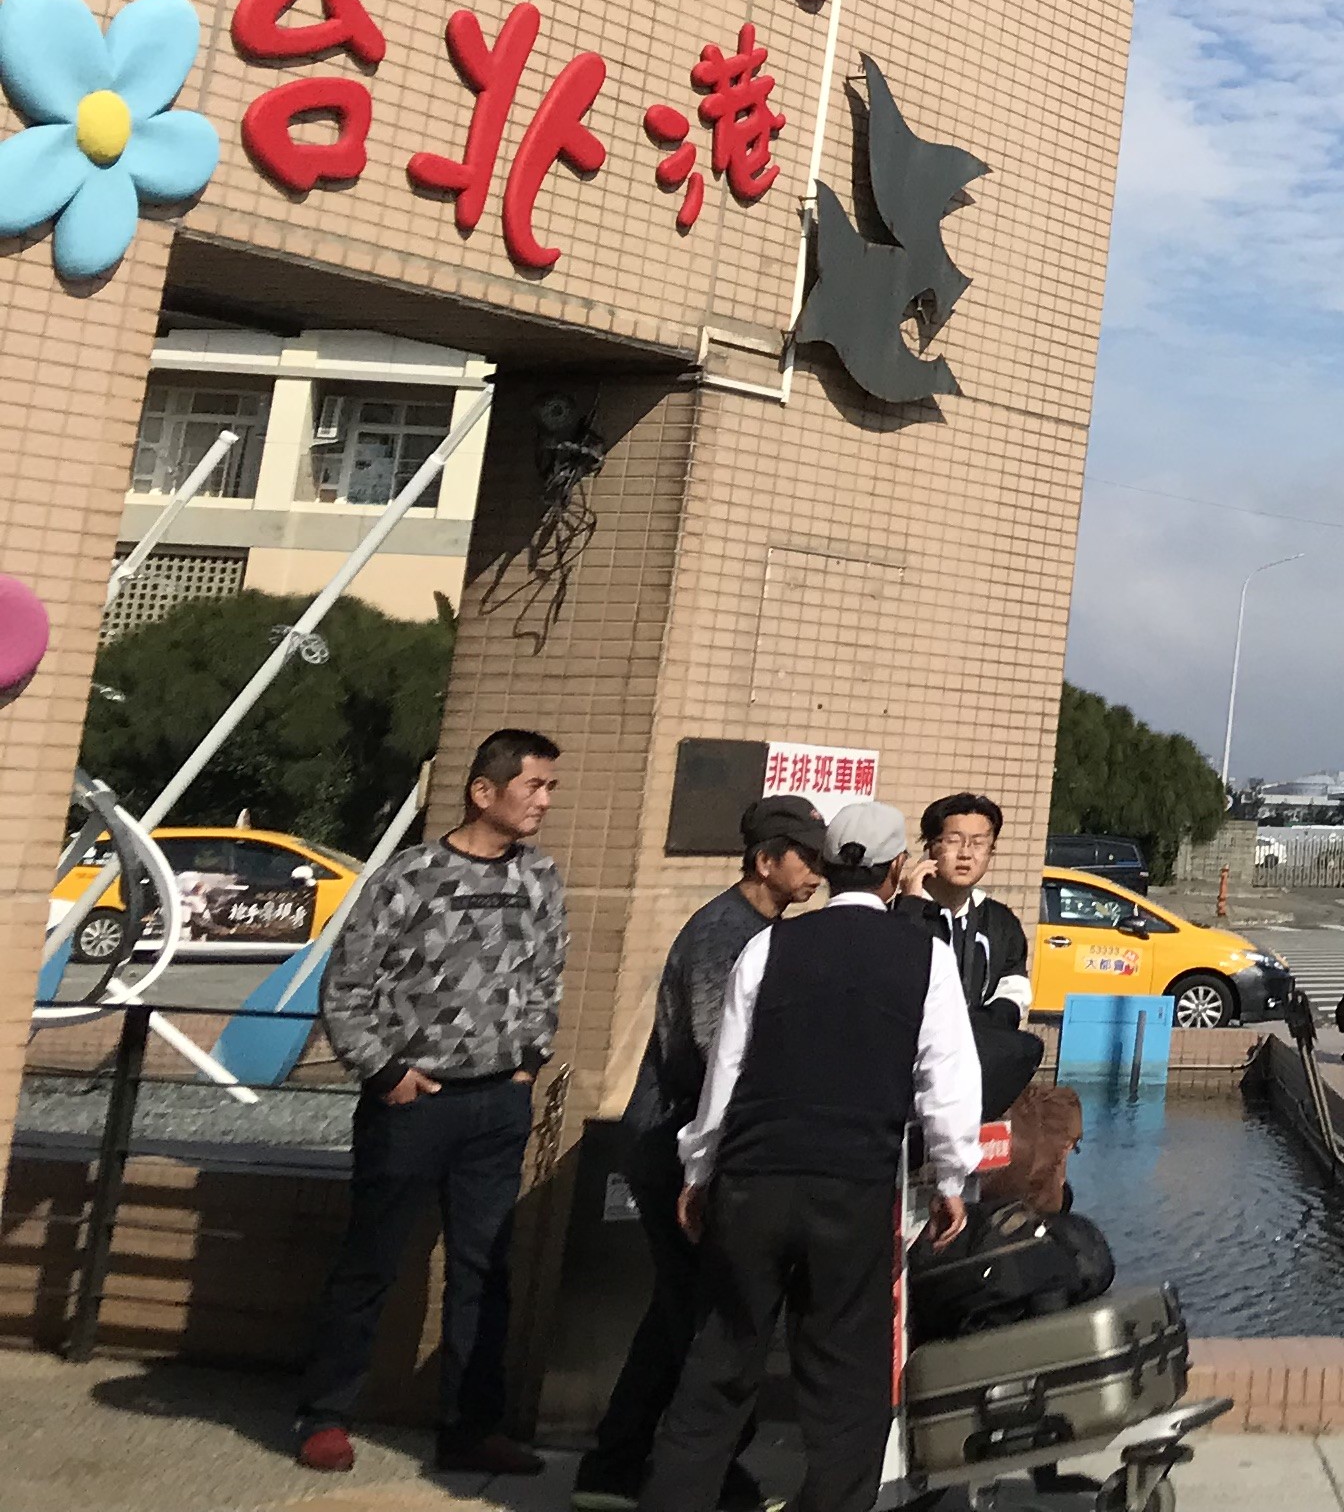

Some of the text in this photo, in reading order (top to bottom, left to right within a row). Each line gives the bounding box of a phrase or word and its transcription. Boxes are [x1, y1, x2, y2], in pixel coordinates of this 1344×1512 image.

[766, 752, 875, 796] 非排班車輛
